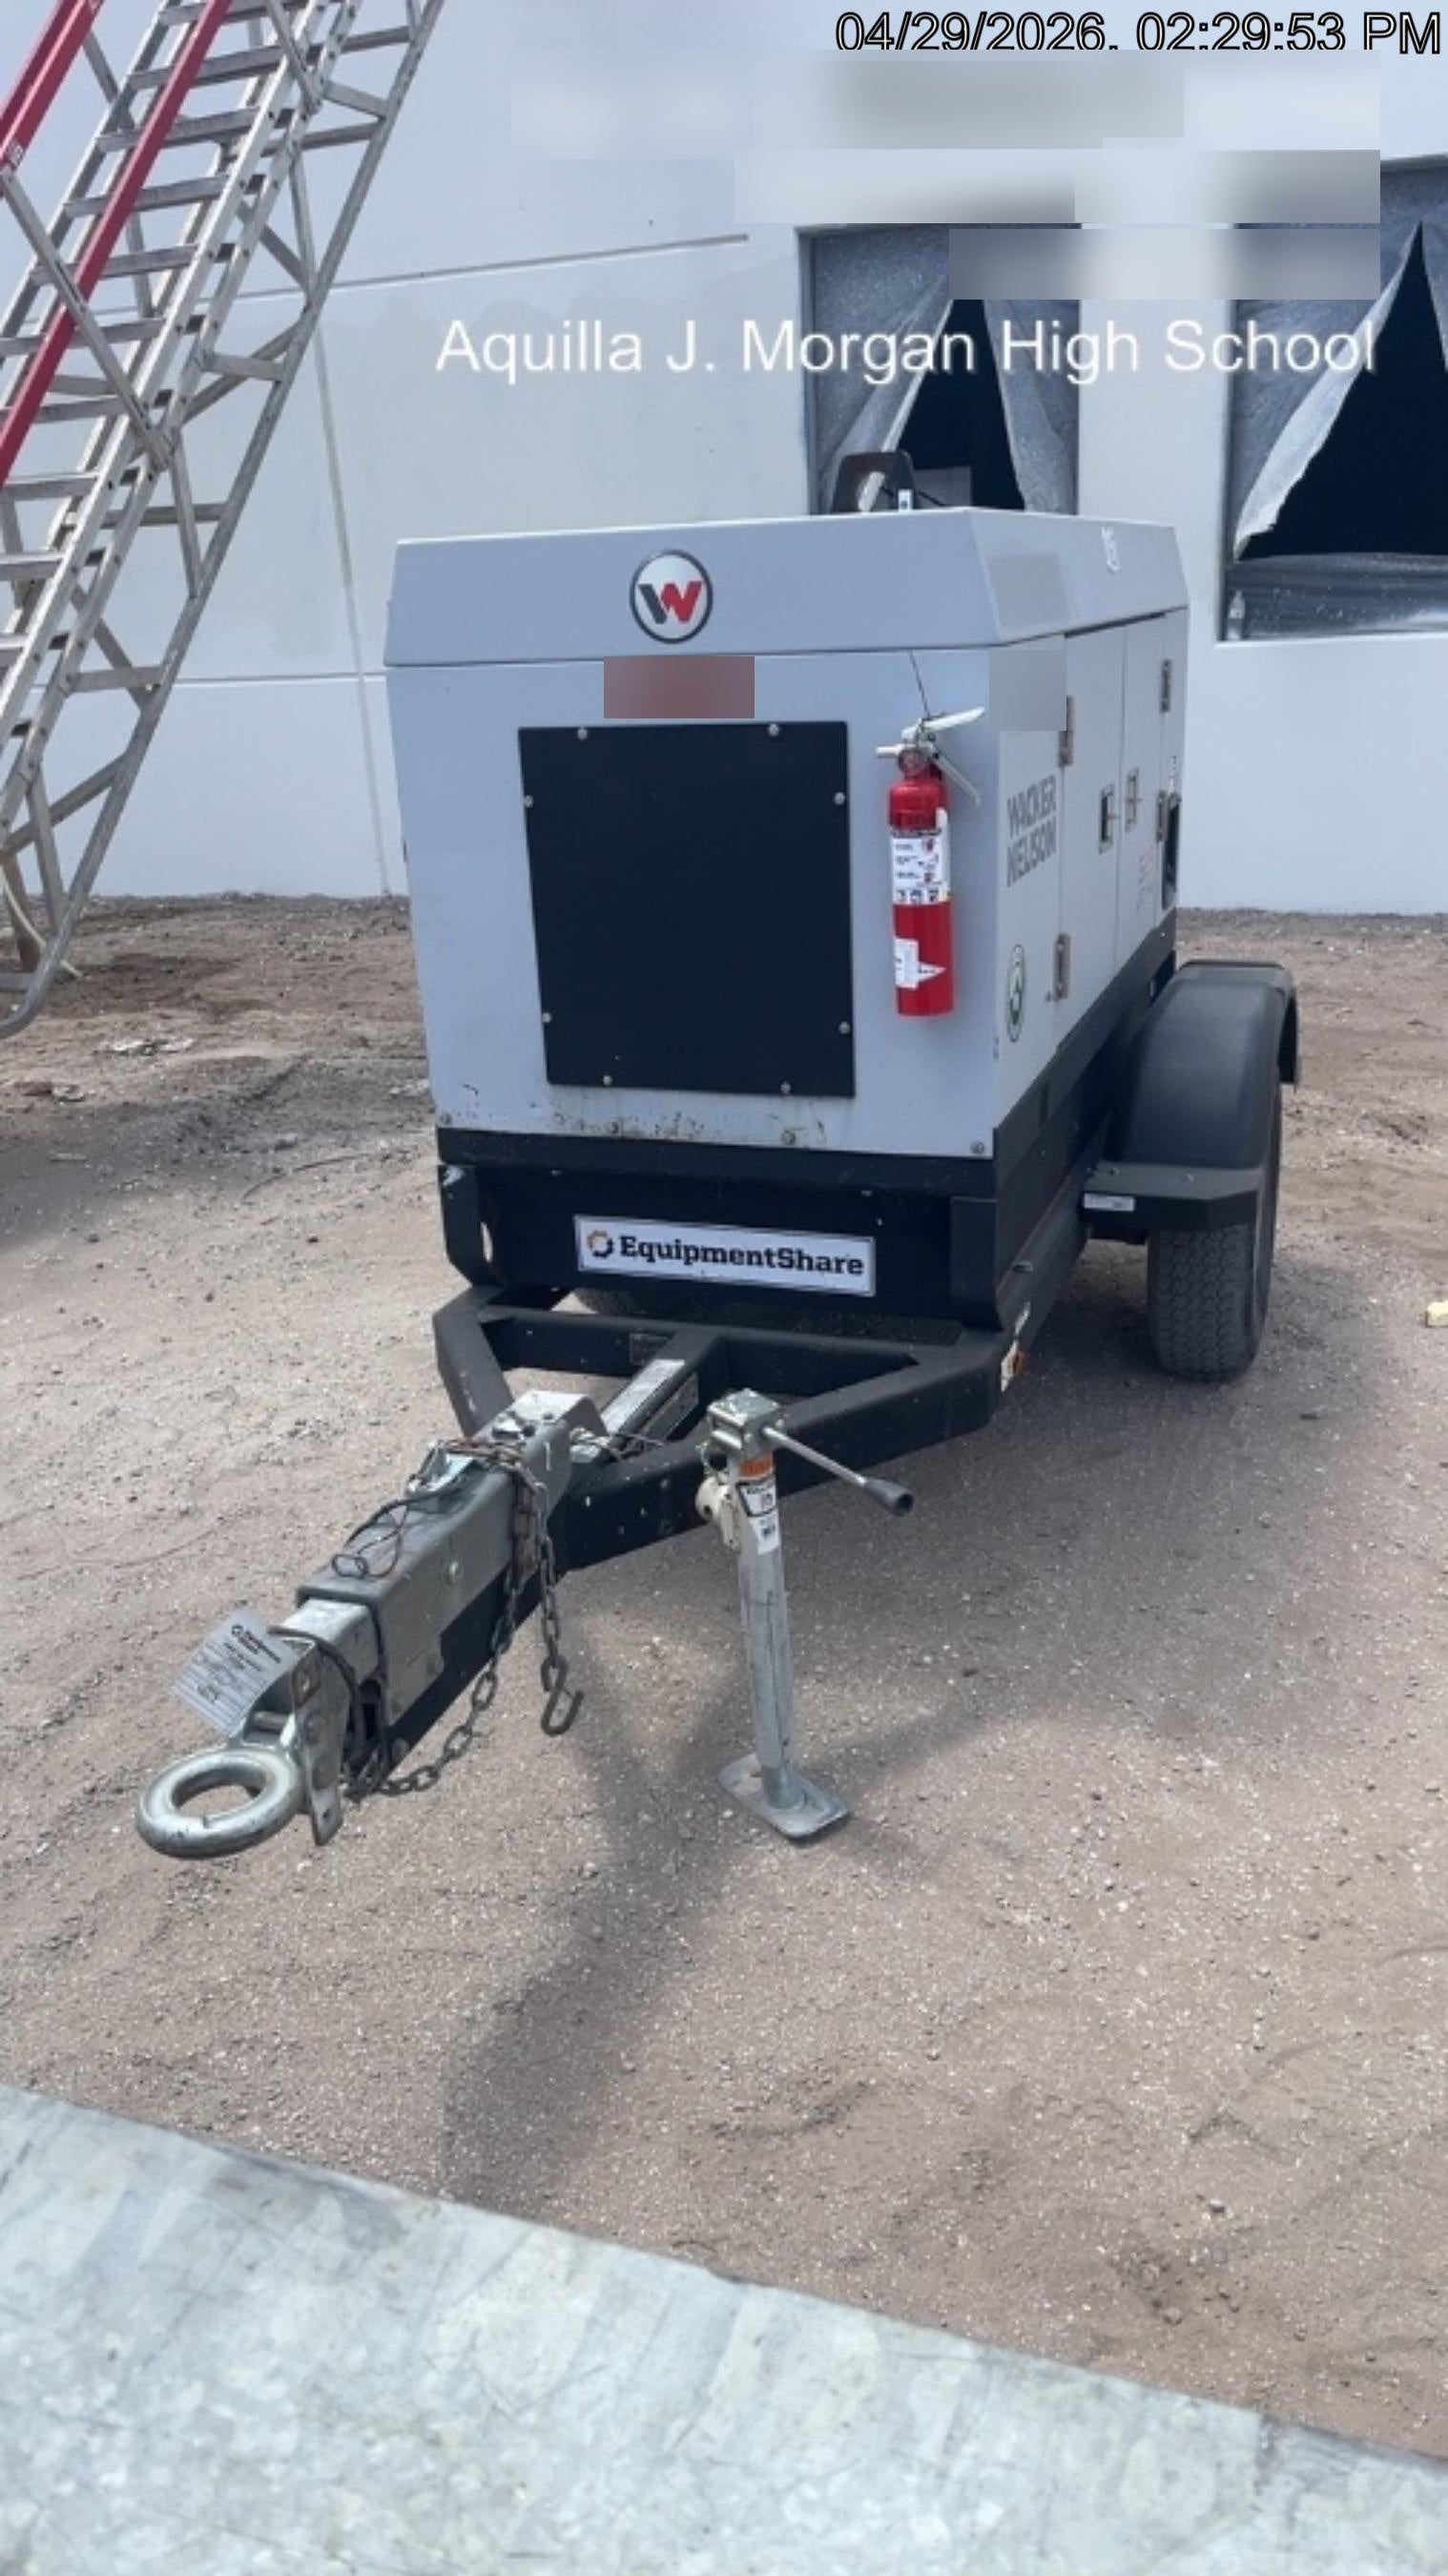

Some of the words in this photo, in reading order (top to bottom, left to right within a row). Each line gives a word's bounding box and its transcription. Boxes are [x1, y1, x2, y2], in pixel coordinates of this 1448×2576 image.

[637, 580, 703, 625] W
[1006, 775, 1057, 840] WACKER
[1006, 815, 1057, 888] NELSON
[619, 1235, 864, 1276] EquipmentShare
